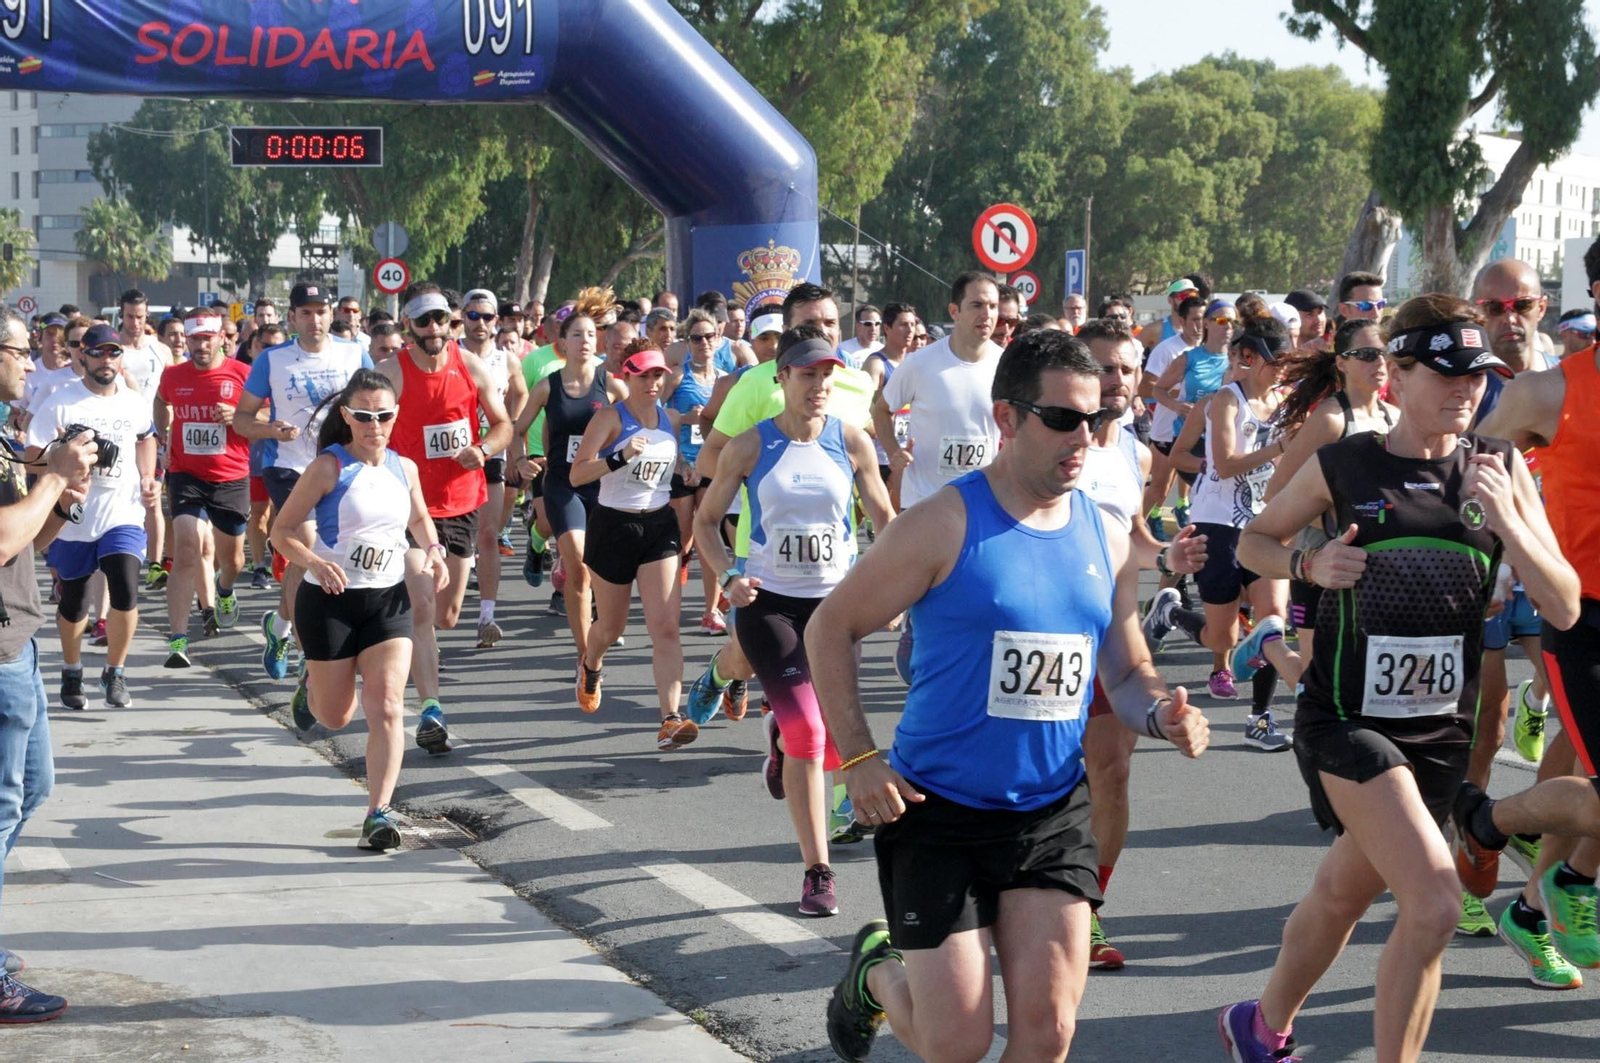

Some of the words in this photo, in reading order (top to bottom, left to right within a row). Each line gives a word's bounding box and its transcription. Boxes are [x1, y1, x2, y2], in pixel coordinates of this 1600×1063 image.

[463, 0, 533, 55] 091
[135, 21, 435, 71] SOLIDARIA
[266, 135, 364, 159] 0:00:06
[381, 269, 403, 282] 40
[1016, 282, 1034, 293] 40
[1068, 257, 1080, 298] P
[203, 293, 214, 306] P
[186, 428, 219, 446] 4046
[430, 427, 468, 452] 4063
[943, 444, 985, 466] 4129
[631, 460, 670, 482] 4077
[350, 544, 394, 572] 4047
[779, 533, 833, 563] 4103
[1000, 648, 1082, 697] 3243
[1374, 652, 1456, 696] 3248
